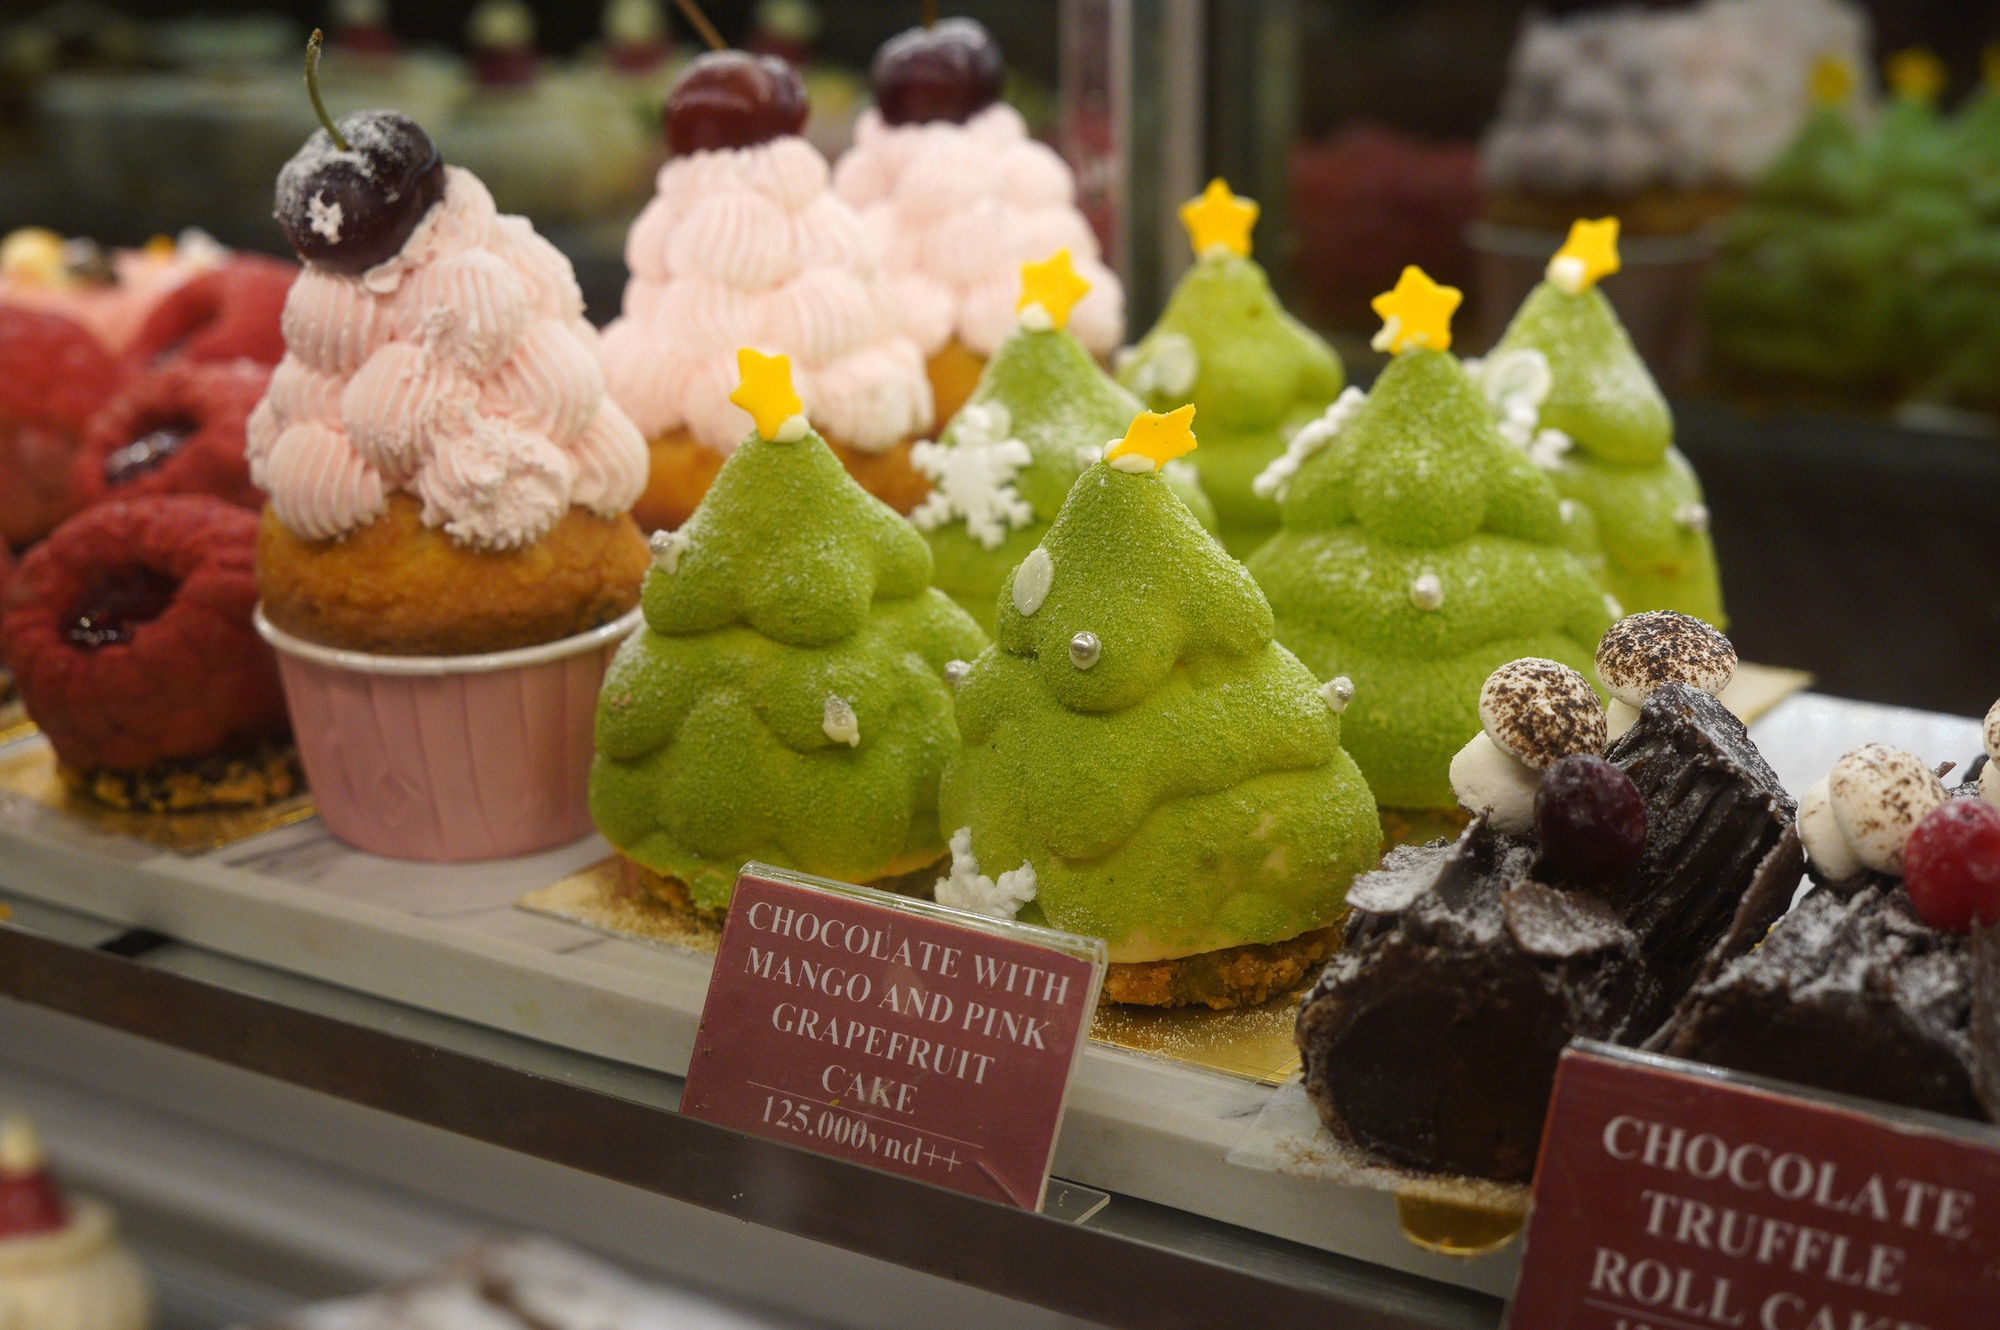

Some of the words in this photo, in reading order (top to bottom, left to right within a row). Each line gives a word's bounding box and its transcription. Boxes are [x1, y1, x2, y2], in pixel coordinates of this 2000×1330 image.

[743, 946, 872, 1003] MANGO
[878, 982, 954, 1024] AND
[962, 1000, 1051, 1051] PINK
[746, 900, 962, 979] CHOCOLATE
[973, 954, 1070, 1006] WITH
[771, 1002, 996, 1085] GRAPEFRUIT
[821, 1064, 919, 1115] CAKE
[762, 1095, 963, 1173] 125.000vnd++
[1602, 1114, 1975, 1241] CHOCOLATE
[1589, 1247, 1745, 1327] ROLL
[1759, 1291, 1930, 1330] CA
[1641, 1188, 1906, 1296] TRUFFLE
